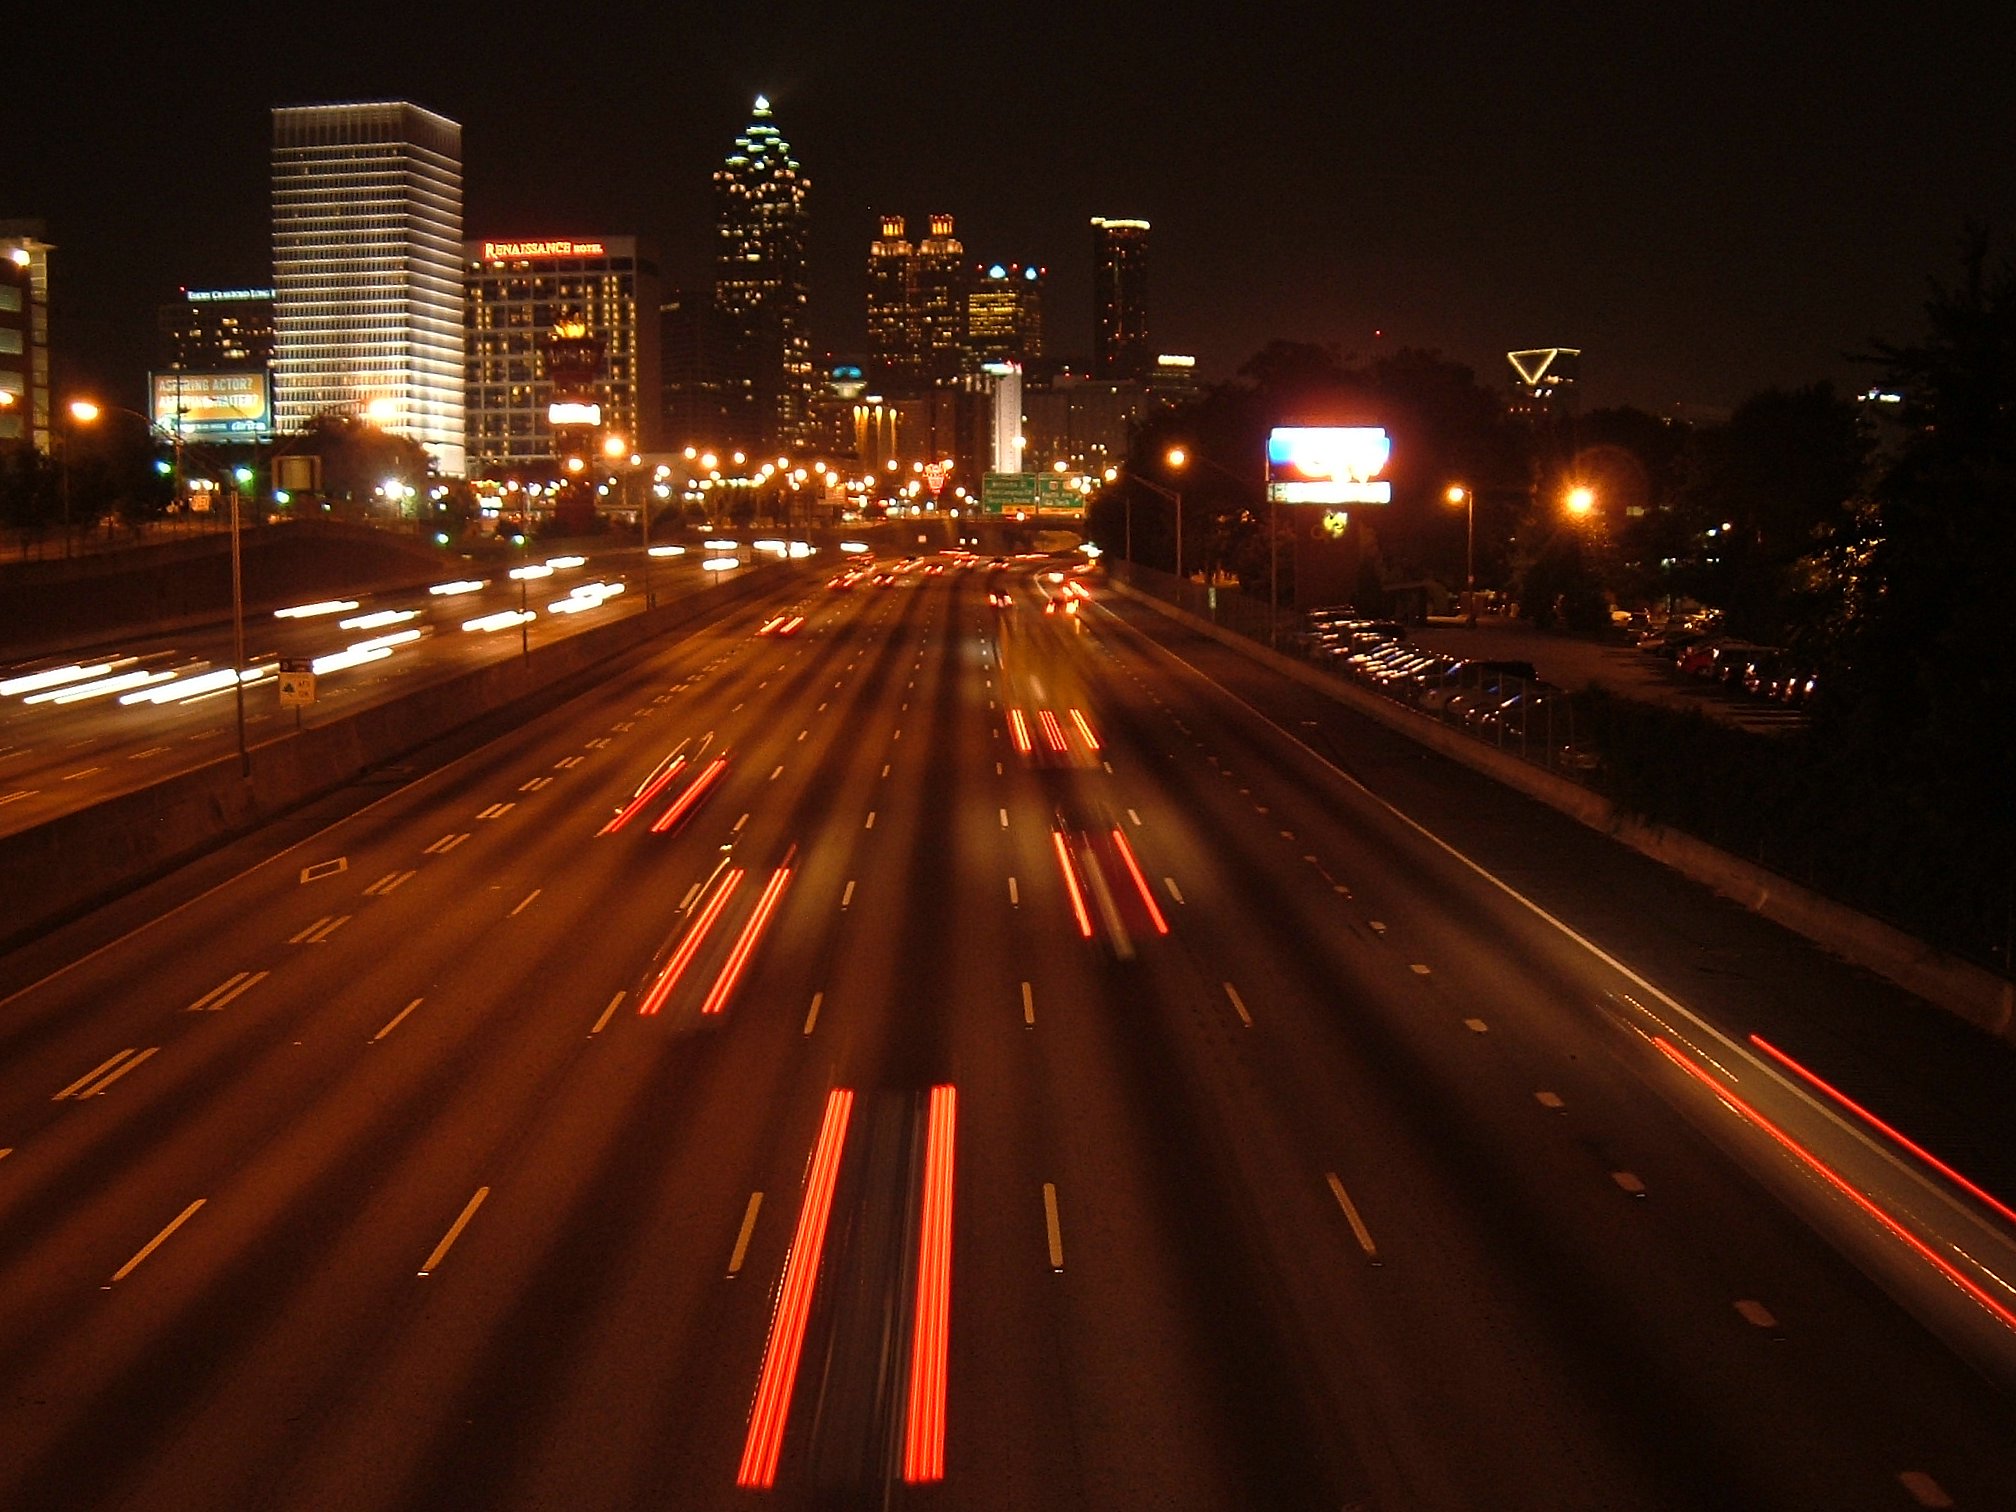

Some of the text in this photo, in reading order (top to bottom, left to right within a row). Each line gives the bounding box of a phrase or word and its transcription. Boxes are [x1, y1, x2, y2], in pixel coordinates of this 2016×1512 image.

[485, 242, 571, 259] RENAISSANCE
[160, 378, 253, 391] ASPRING ACTOR?
